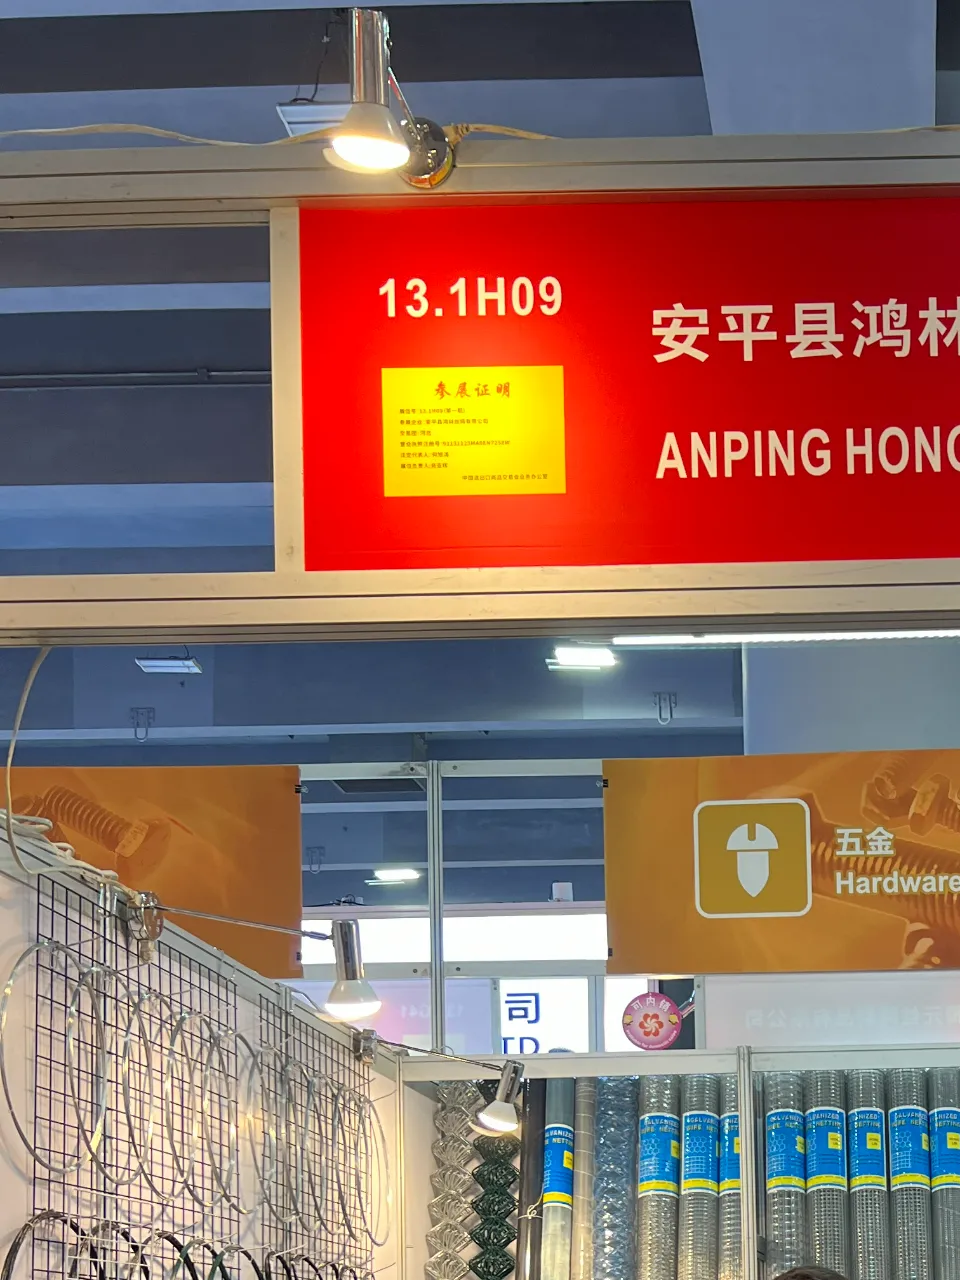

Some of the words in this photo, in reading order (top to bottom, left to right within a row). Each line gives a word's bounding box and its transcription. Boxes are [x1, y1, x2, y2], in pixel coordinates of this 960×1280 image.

[379, 276, 562, 318] 13.1H09
[435, 381, 511, 400] 参展证明
[655, 428, 832, 479] ANPING
[835, 827, 895, 857] 五金
[631, 996, 671, 1012] 可内销
